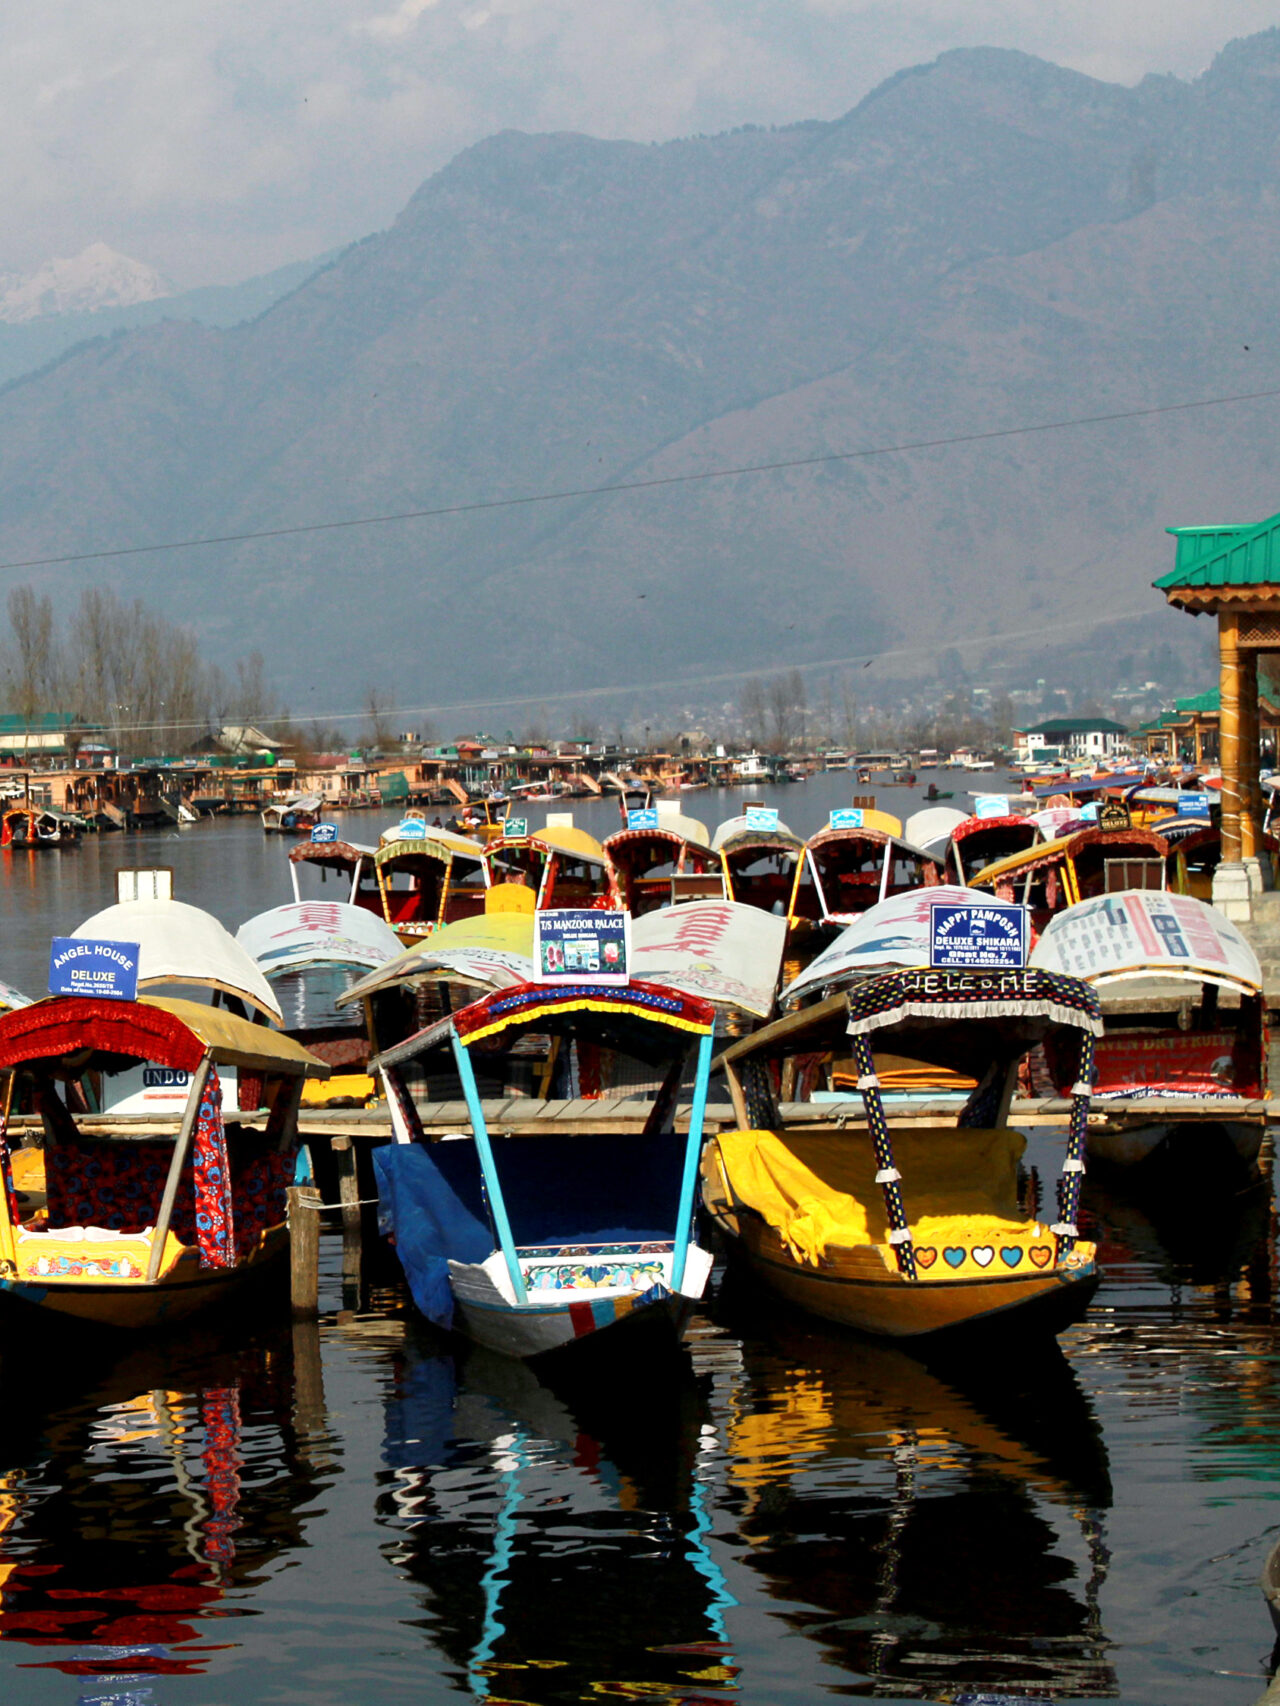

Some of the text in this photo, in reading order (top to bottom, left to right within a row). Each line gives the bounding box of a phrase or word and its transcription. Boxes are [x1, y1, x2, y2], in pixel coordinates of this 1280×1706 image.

[553, 919, 594, 931] MANZOOR
[595, 918, 624, 930] PALACE
[936, 909, 1019, 938] HAPPY PAMPOSH
[935, 936, 1020, 946] DELUXE SHIKARA
[53, 944, 134, 971] ANGEL HOUSE
[71, 969, 116, 982] DELUXE
[901, 972, 1038, 994] WELCOME
[145, 1070, 187, 1084] INDO
